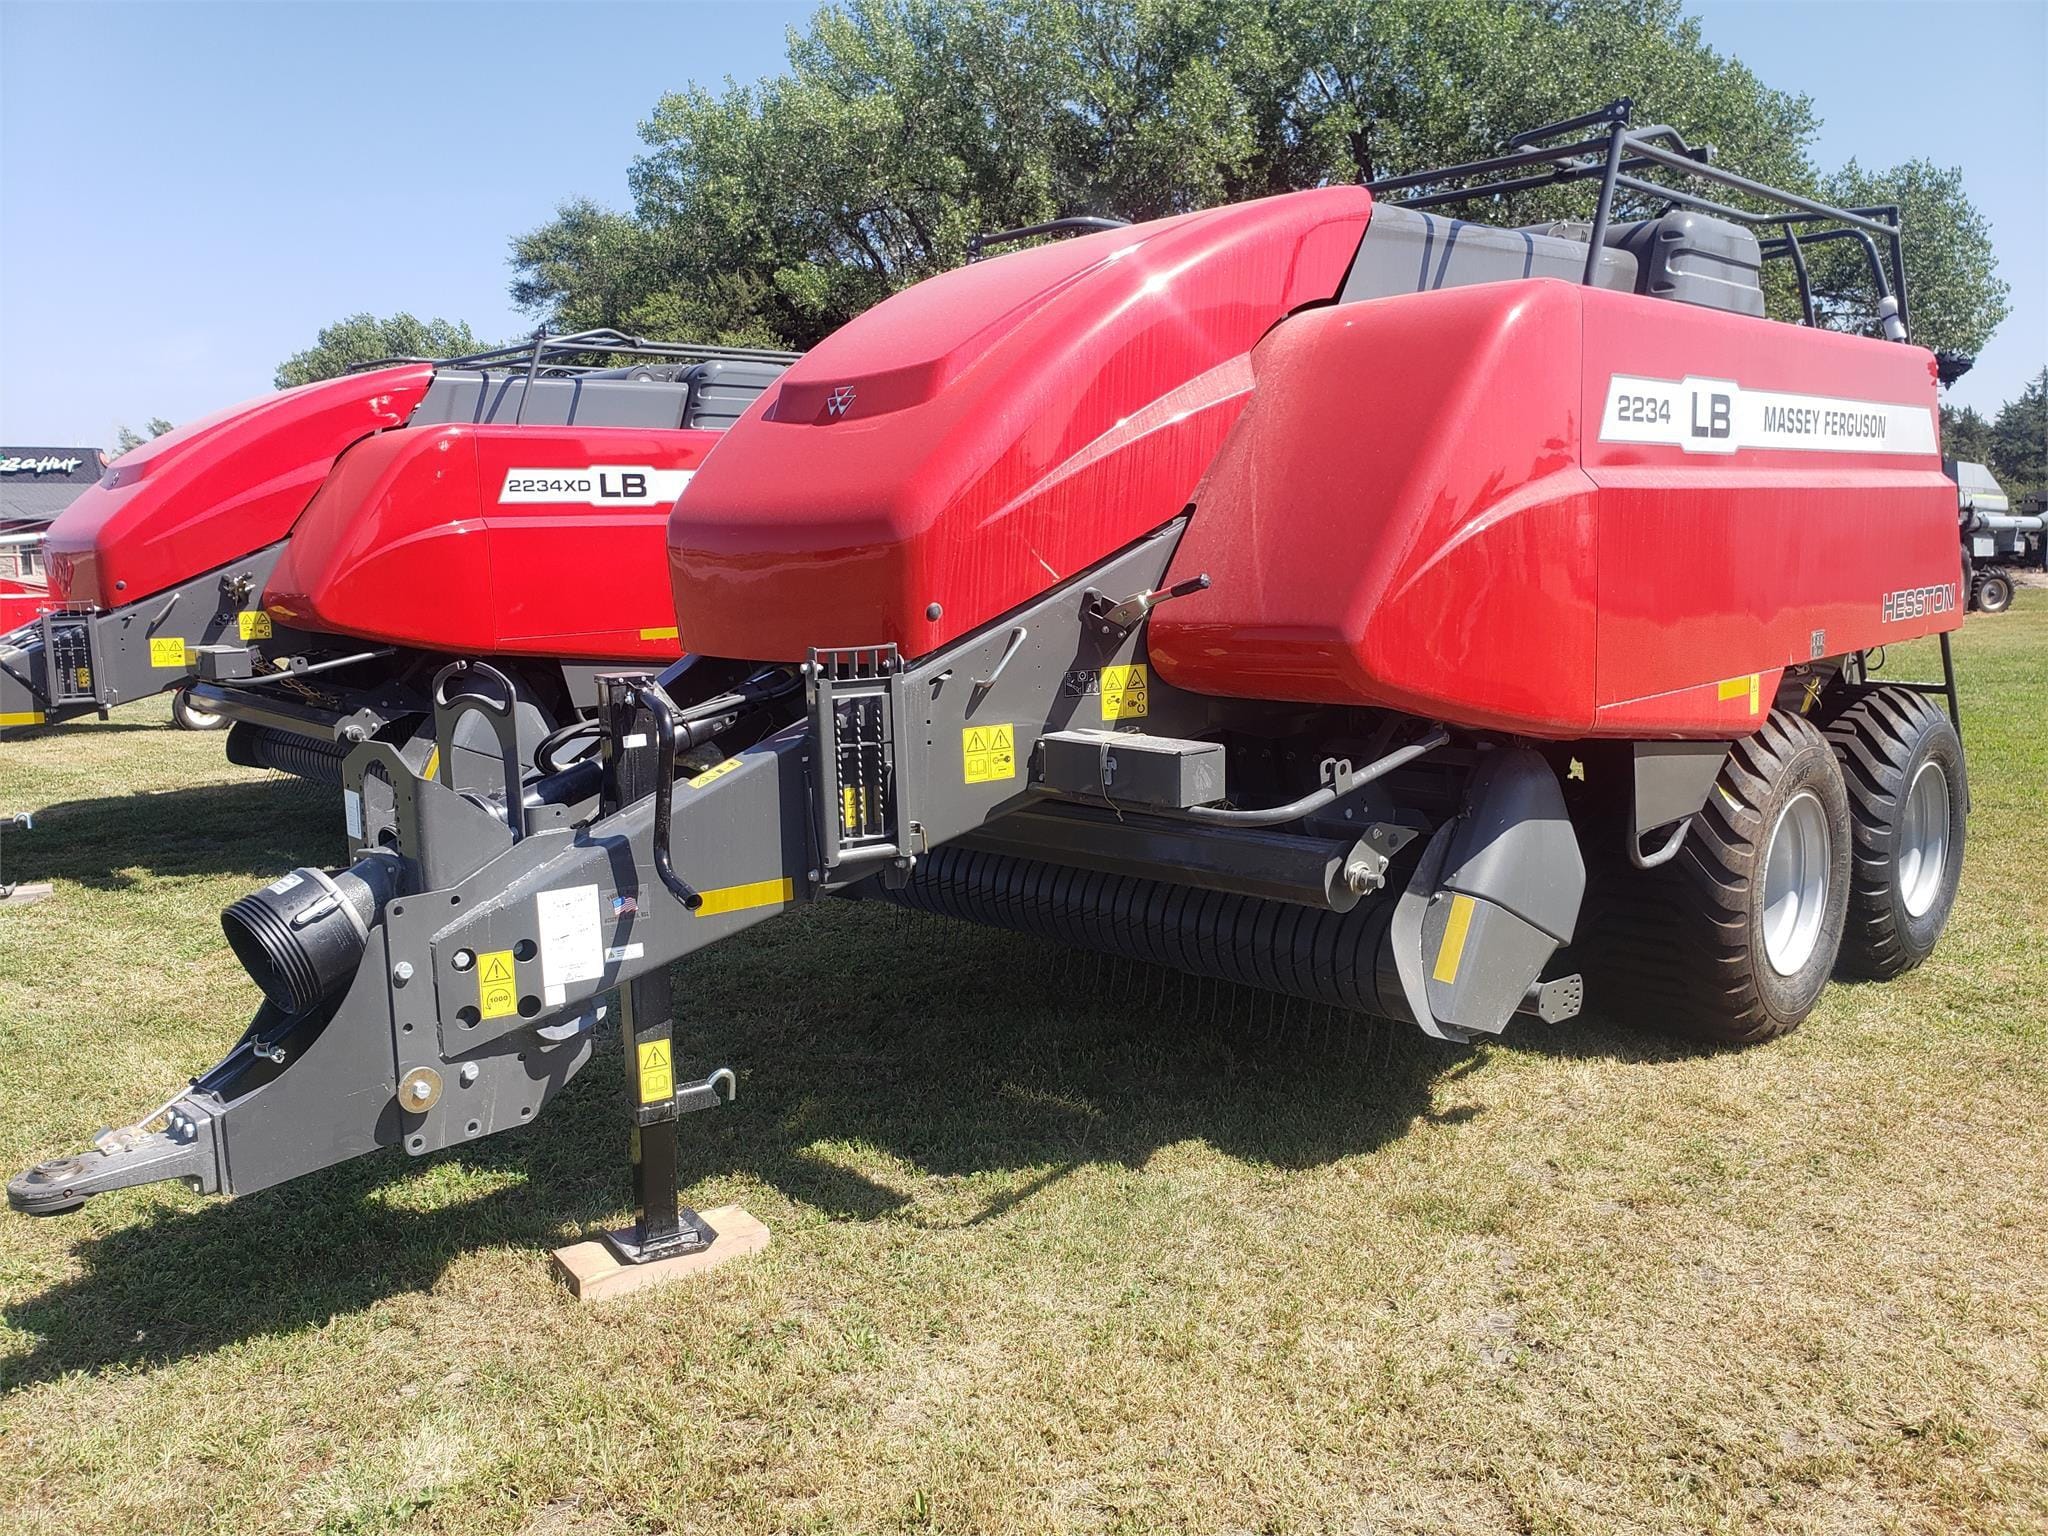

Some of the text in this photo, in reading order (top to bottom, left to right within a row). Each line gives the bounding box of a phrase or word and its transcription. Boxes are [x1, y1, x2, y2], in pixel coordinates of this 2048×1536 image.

[1617, 391, 1886, 439] 2234 LB MASSEY FERGUSON
[0, 454, 82, 472] zza Hut
[508, 472, 648, 499] 2234XD LB
[1882, 584, 1955, 622] HESSTON
